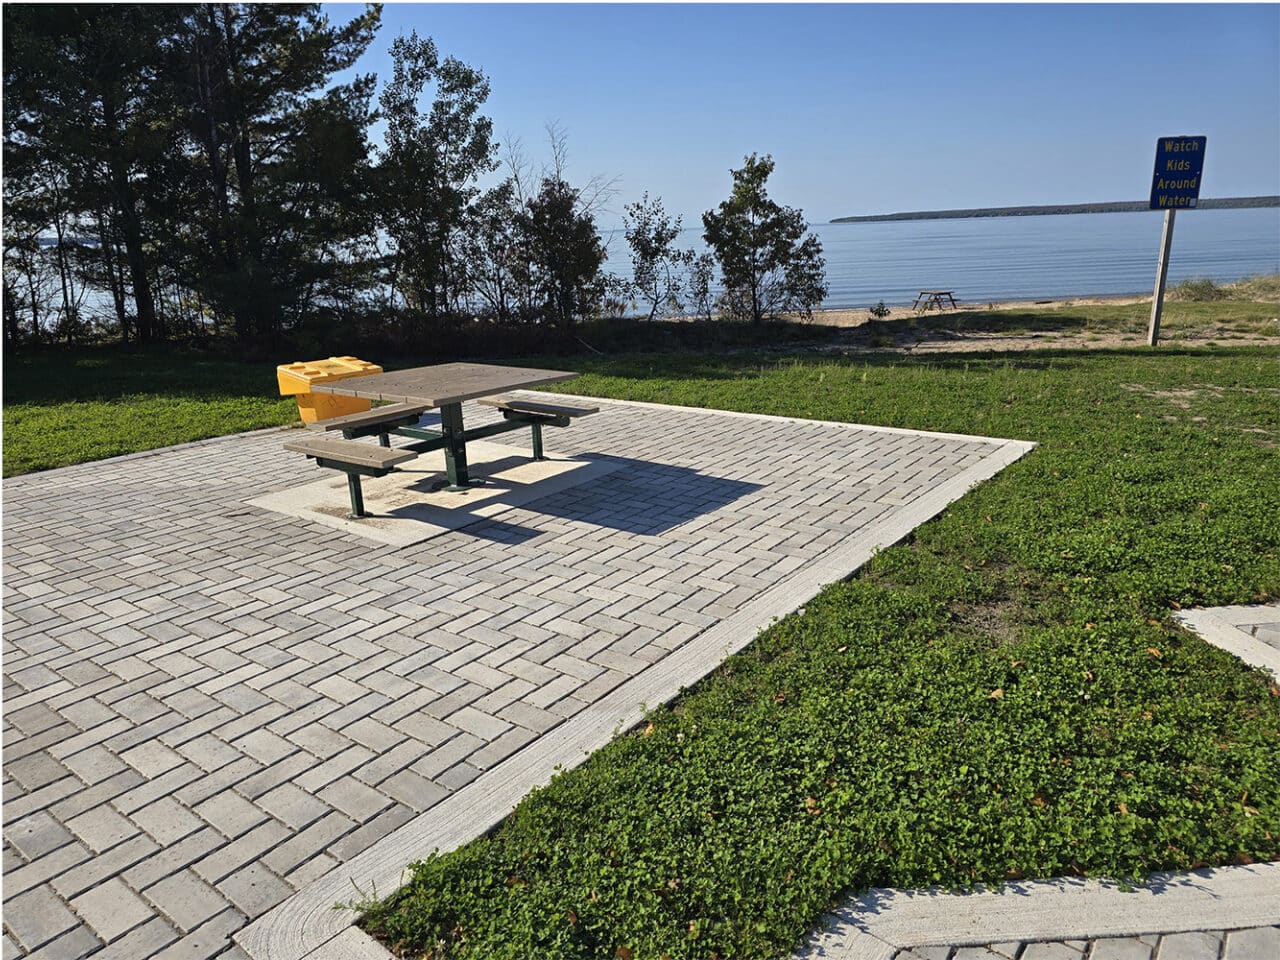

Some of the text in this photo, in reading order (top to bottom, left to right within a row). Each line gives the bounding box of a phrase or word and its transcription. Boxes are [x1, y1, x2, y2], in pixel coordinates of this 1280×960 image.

[1165, 140, 1199, 152] Watch
[1167, 160, 1190, 171] Kids
[1157, 177, 1197, 189] Around
[1159, 195, 1190, 207] Water
